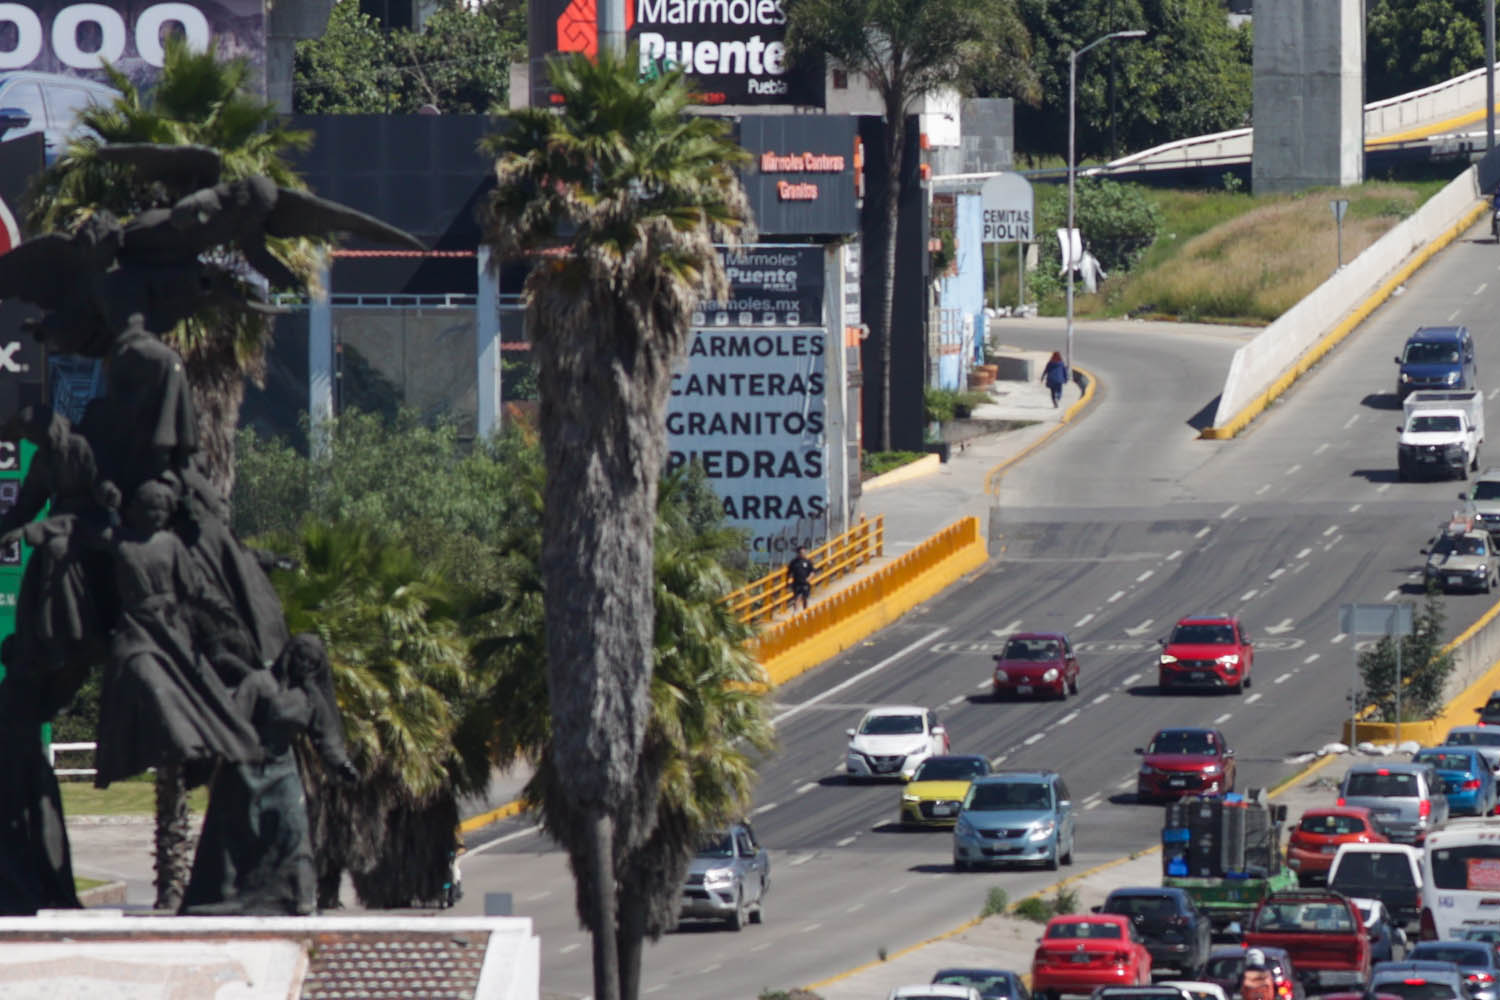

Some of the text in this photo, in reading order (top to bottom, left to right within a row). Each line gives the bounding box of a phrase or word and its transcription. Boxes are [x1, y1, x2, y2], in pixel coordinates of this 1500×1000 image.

[639, 32, 787, 75] Puente
[983, 224, 1030, 239] PIOLIN
[727, 267, 798, 283] Puente
[690, 331, 824, 357] ÁRMOLES
[671, 373, 825, 396] CANTERAS
[666, 412, 824, 435] GRANITOS
[723, 496, 826, 520] ARRAS
